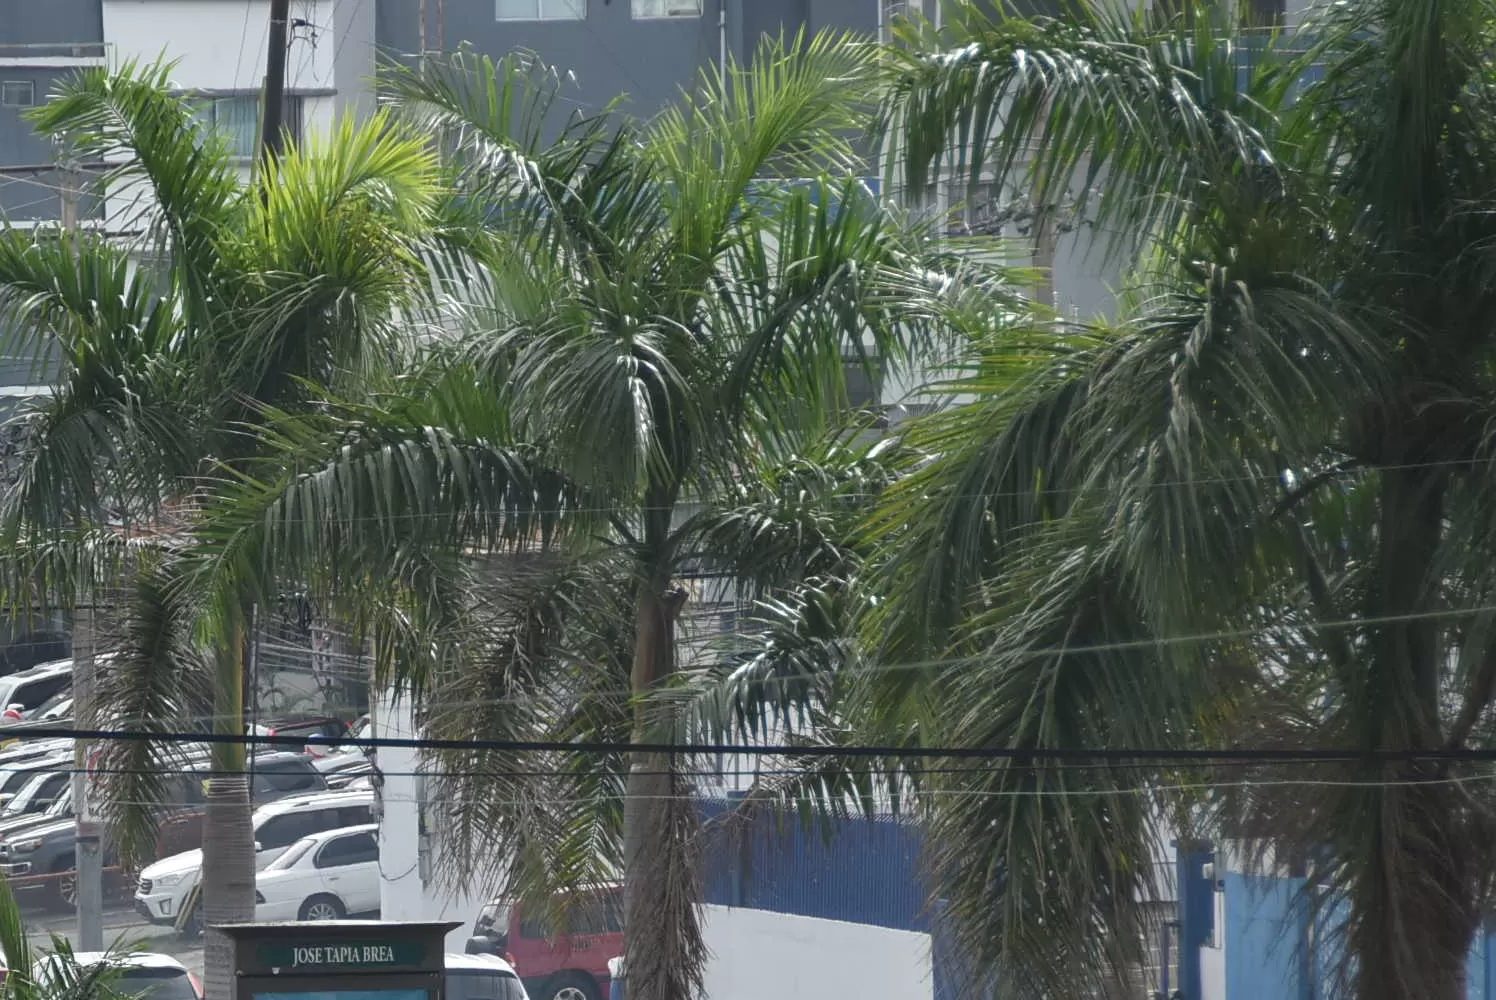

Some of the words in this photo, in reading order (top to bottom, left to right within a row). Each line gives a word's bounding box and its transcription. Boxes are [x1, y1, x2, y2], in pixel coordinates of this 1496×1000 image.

[292, 947, 323, 968] JOSE
[324, 947, 361, 964] TAPIA
[362, 946, 395, 963] BREA
